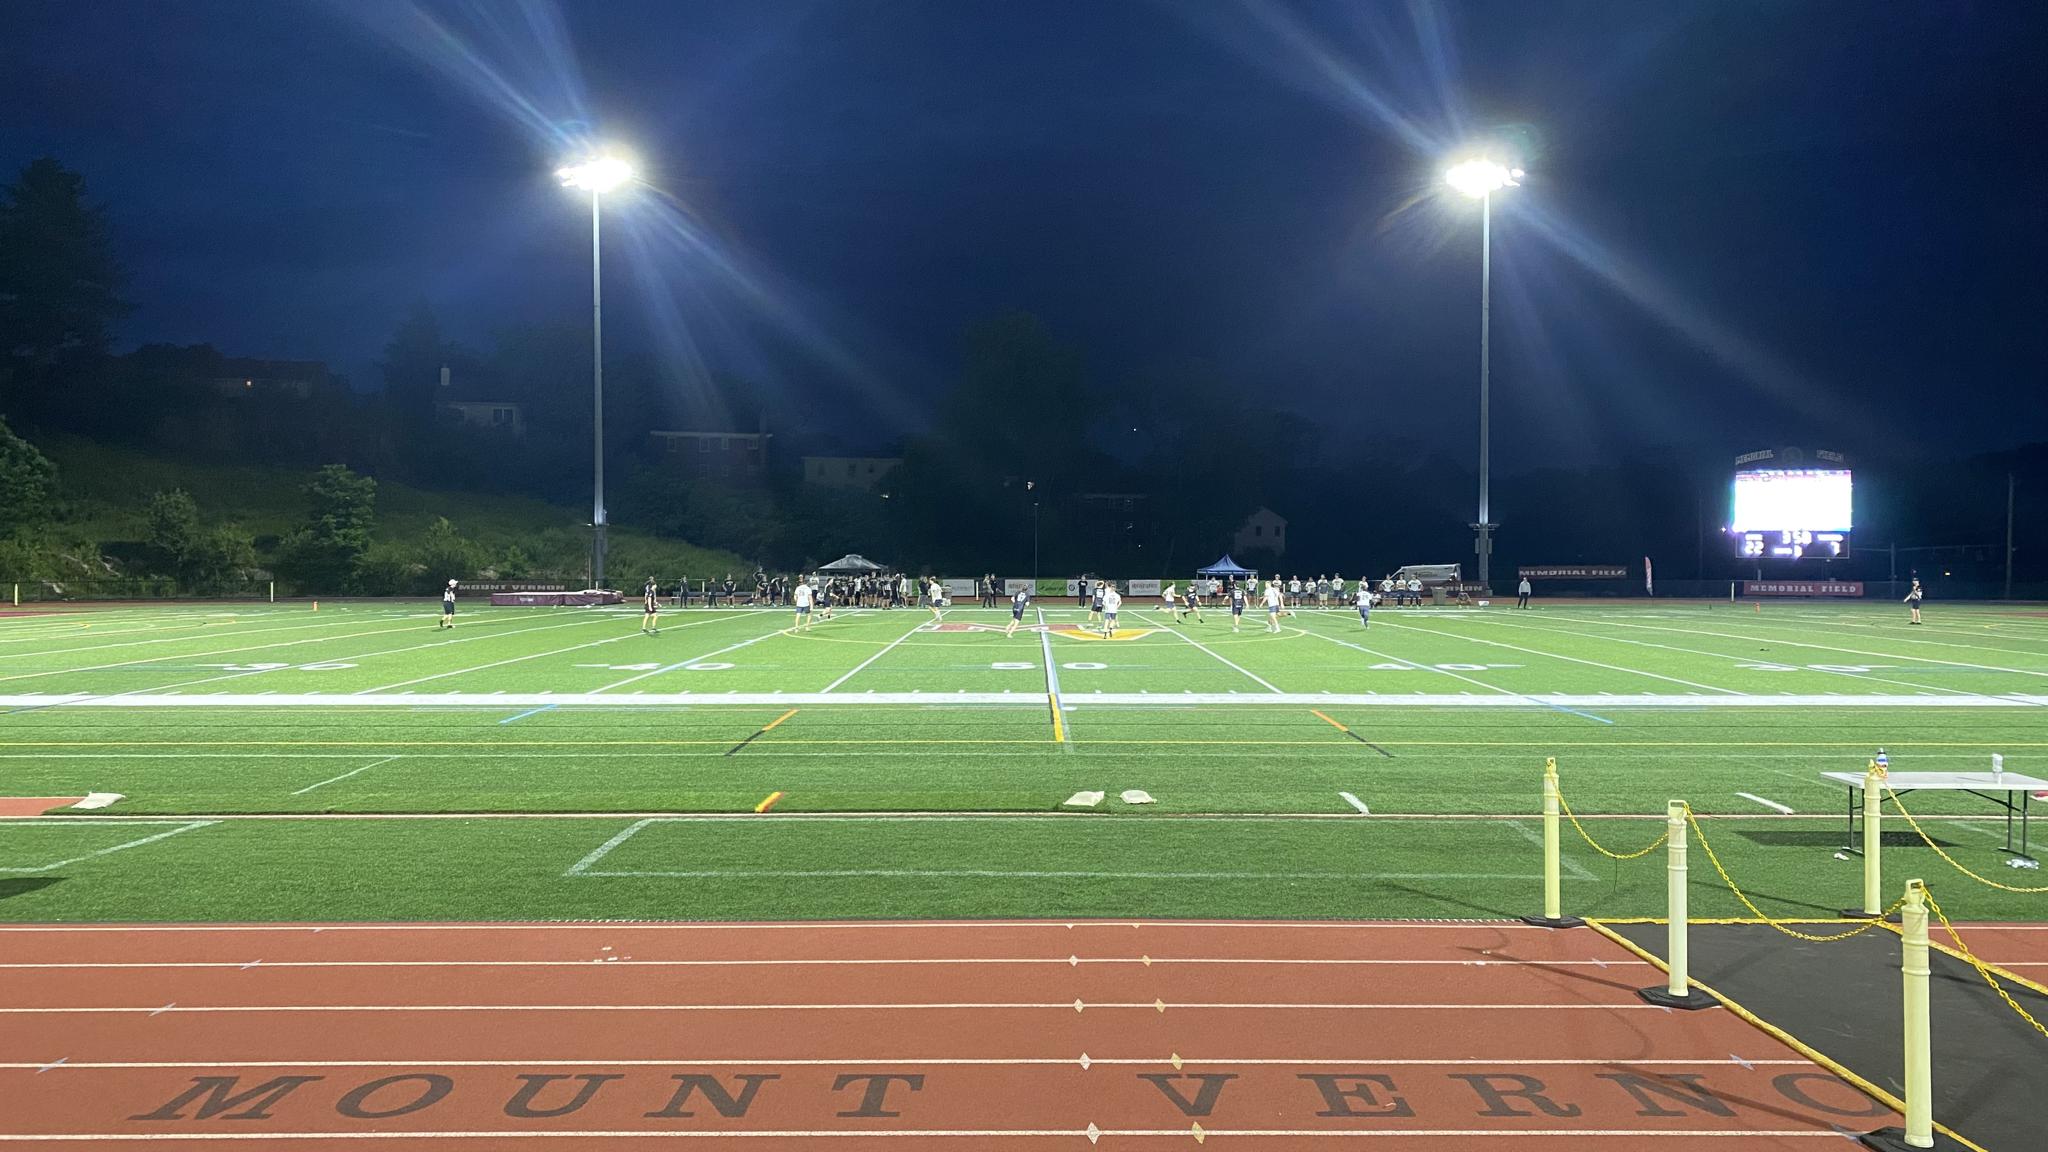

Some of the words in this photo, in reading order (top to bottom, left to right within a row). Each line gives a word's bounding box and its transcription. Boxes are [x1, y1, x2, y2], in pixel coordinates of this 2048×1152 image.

[1750, 584, 1814, 593] MEMORIAL
[1822, 584, 1857, 593] FIELD
[126, 1074, 926, 1119] MOUNT
